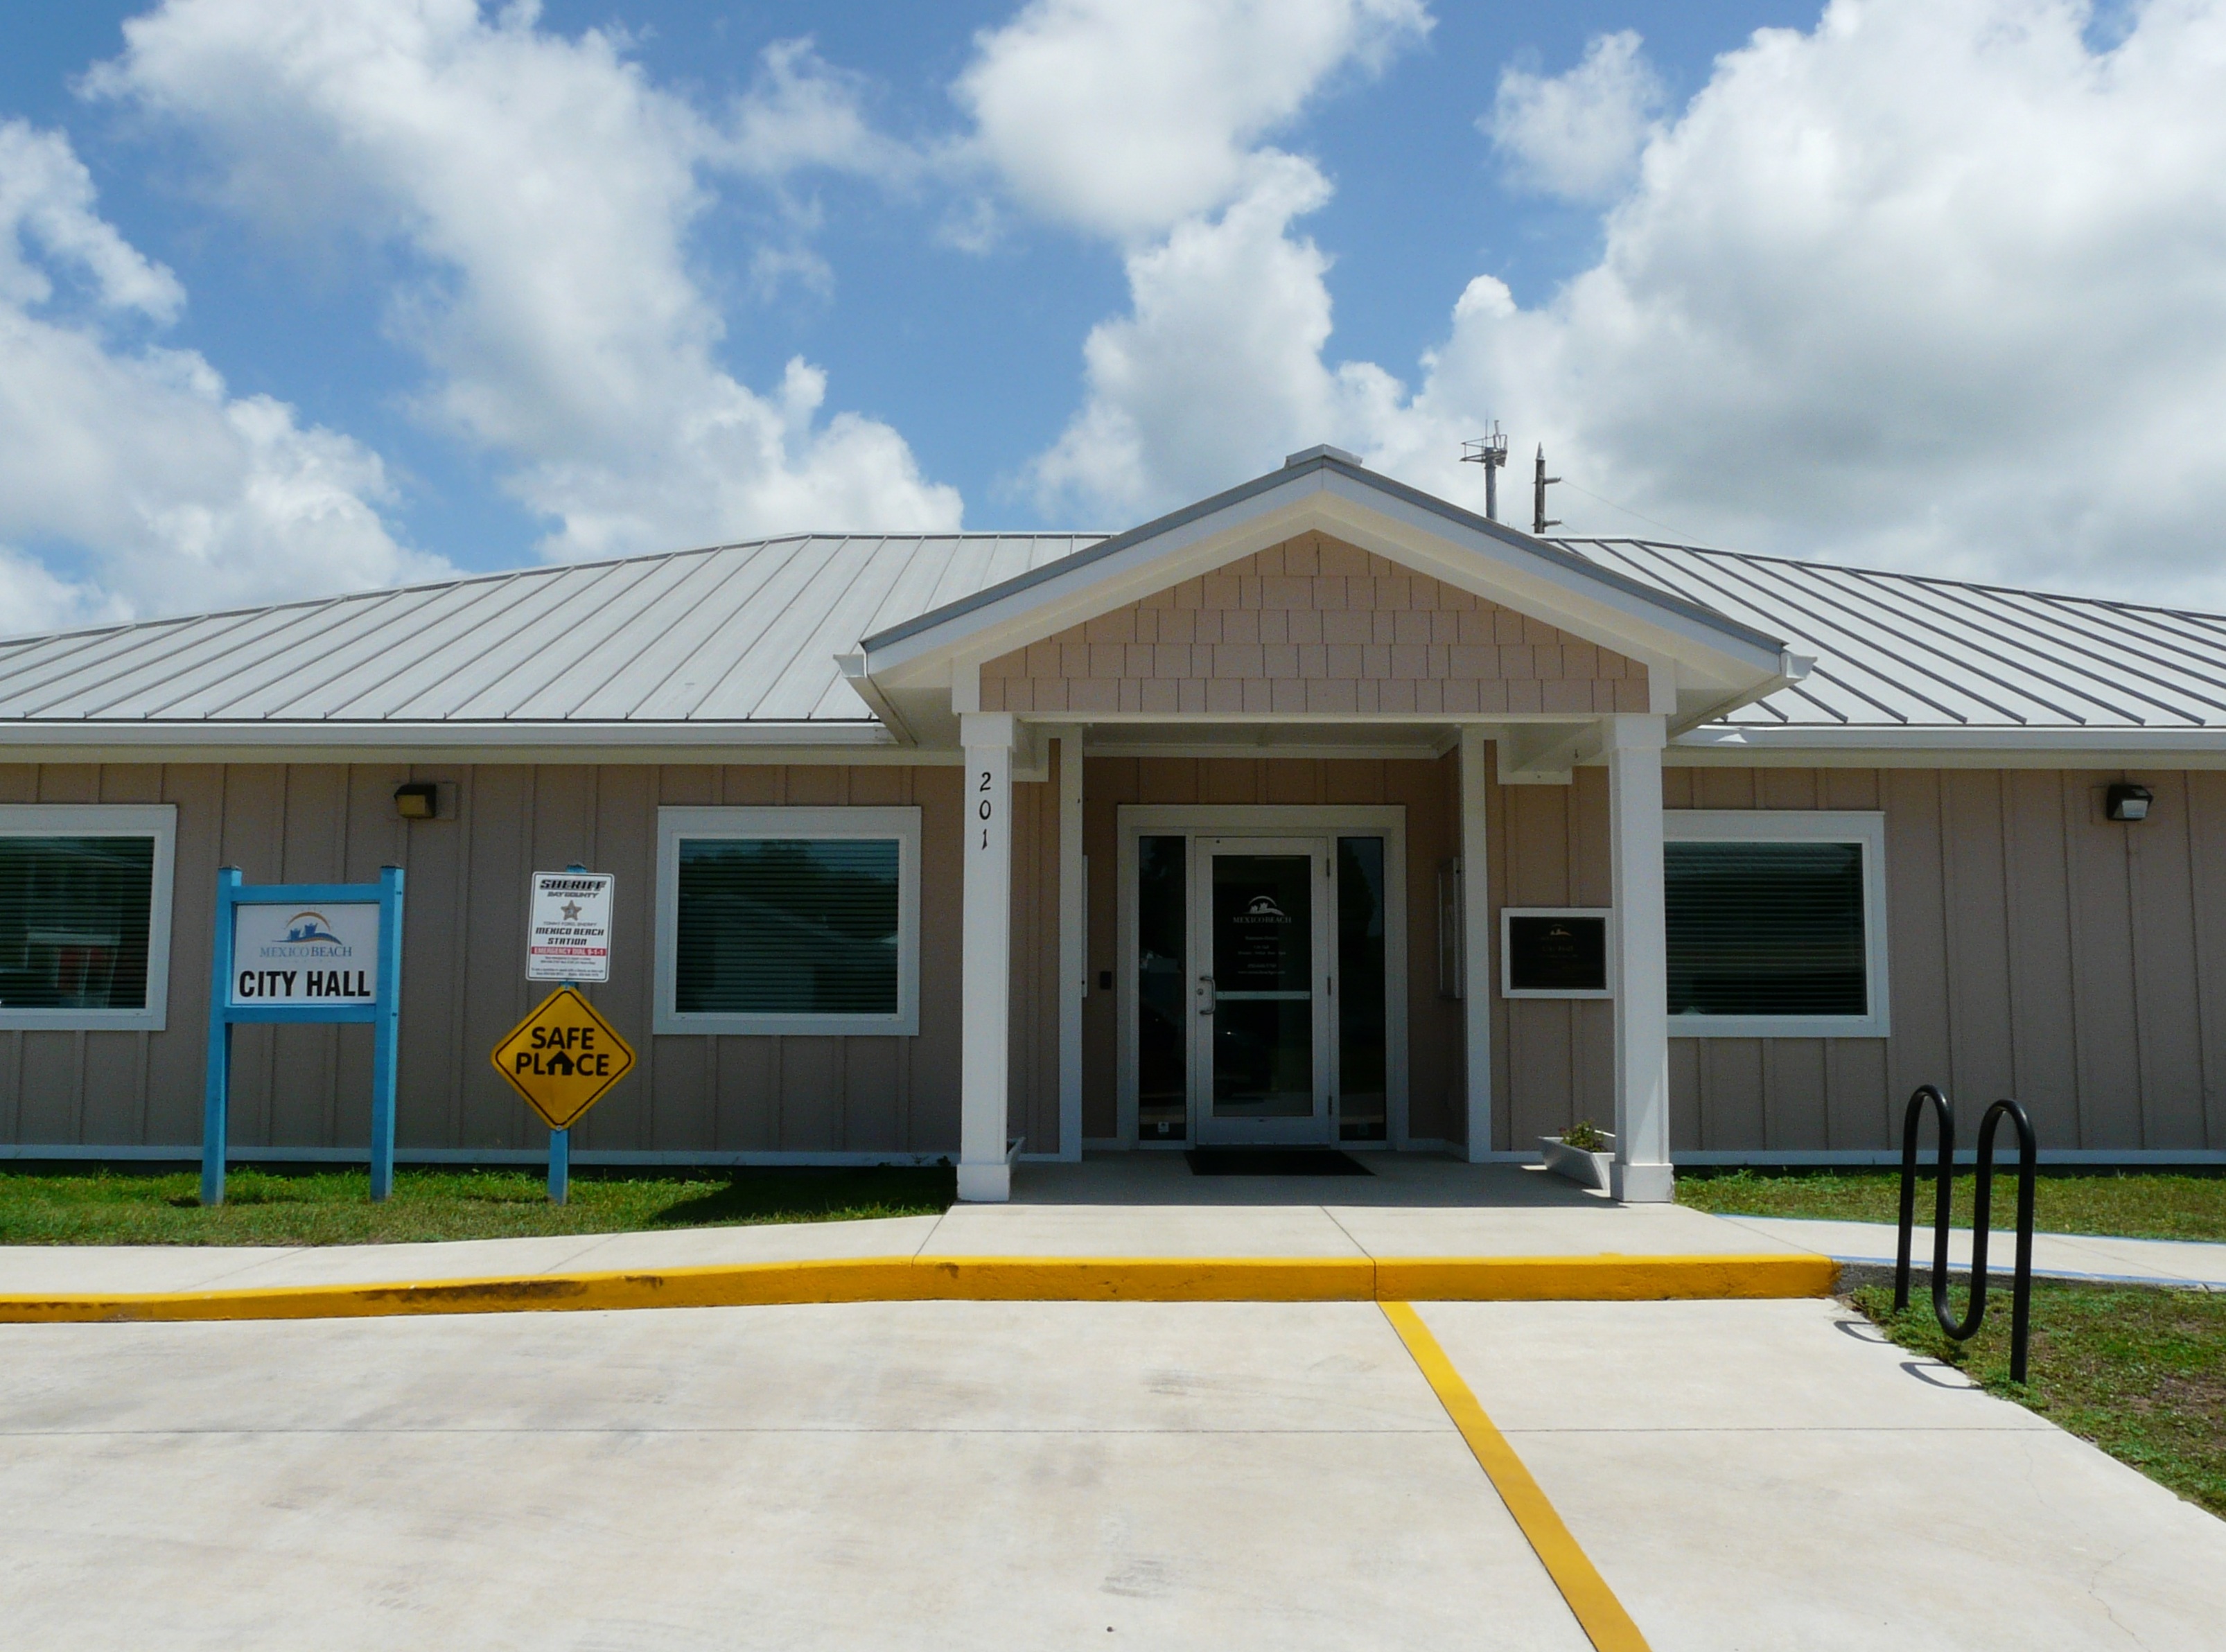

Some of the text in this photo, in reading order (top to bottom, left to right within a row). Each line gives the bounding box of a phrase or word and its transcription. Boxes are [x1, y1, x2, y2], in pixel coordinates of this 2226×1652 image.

[979, 772, 991, 850] 201
[540, 879, 606, 891] SHERIFF
[259, 947, 352, 957] MEXICO BEACH
[239, 971, 370, 996] CITY HALL
[531, 1027, 594, 1049] SAFE
